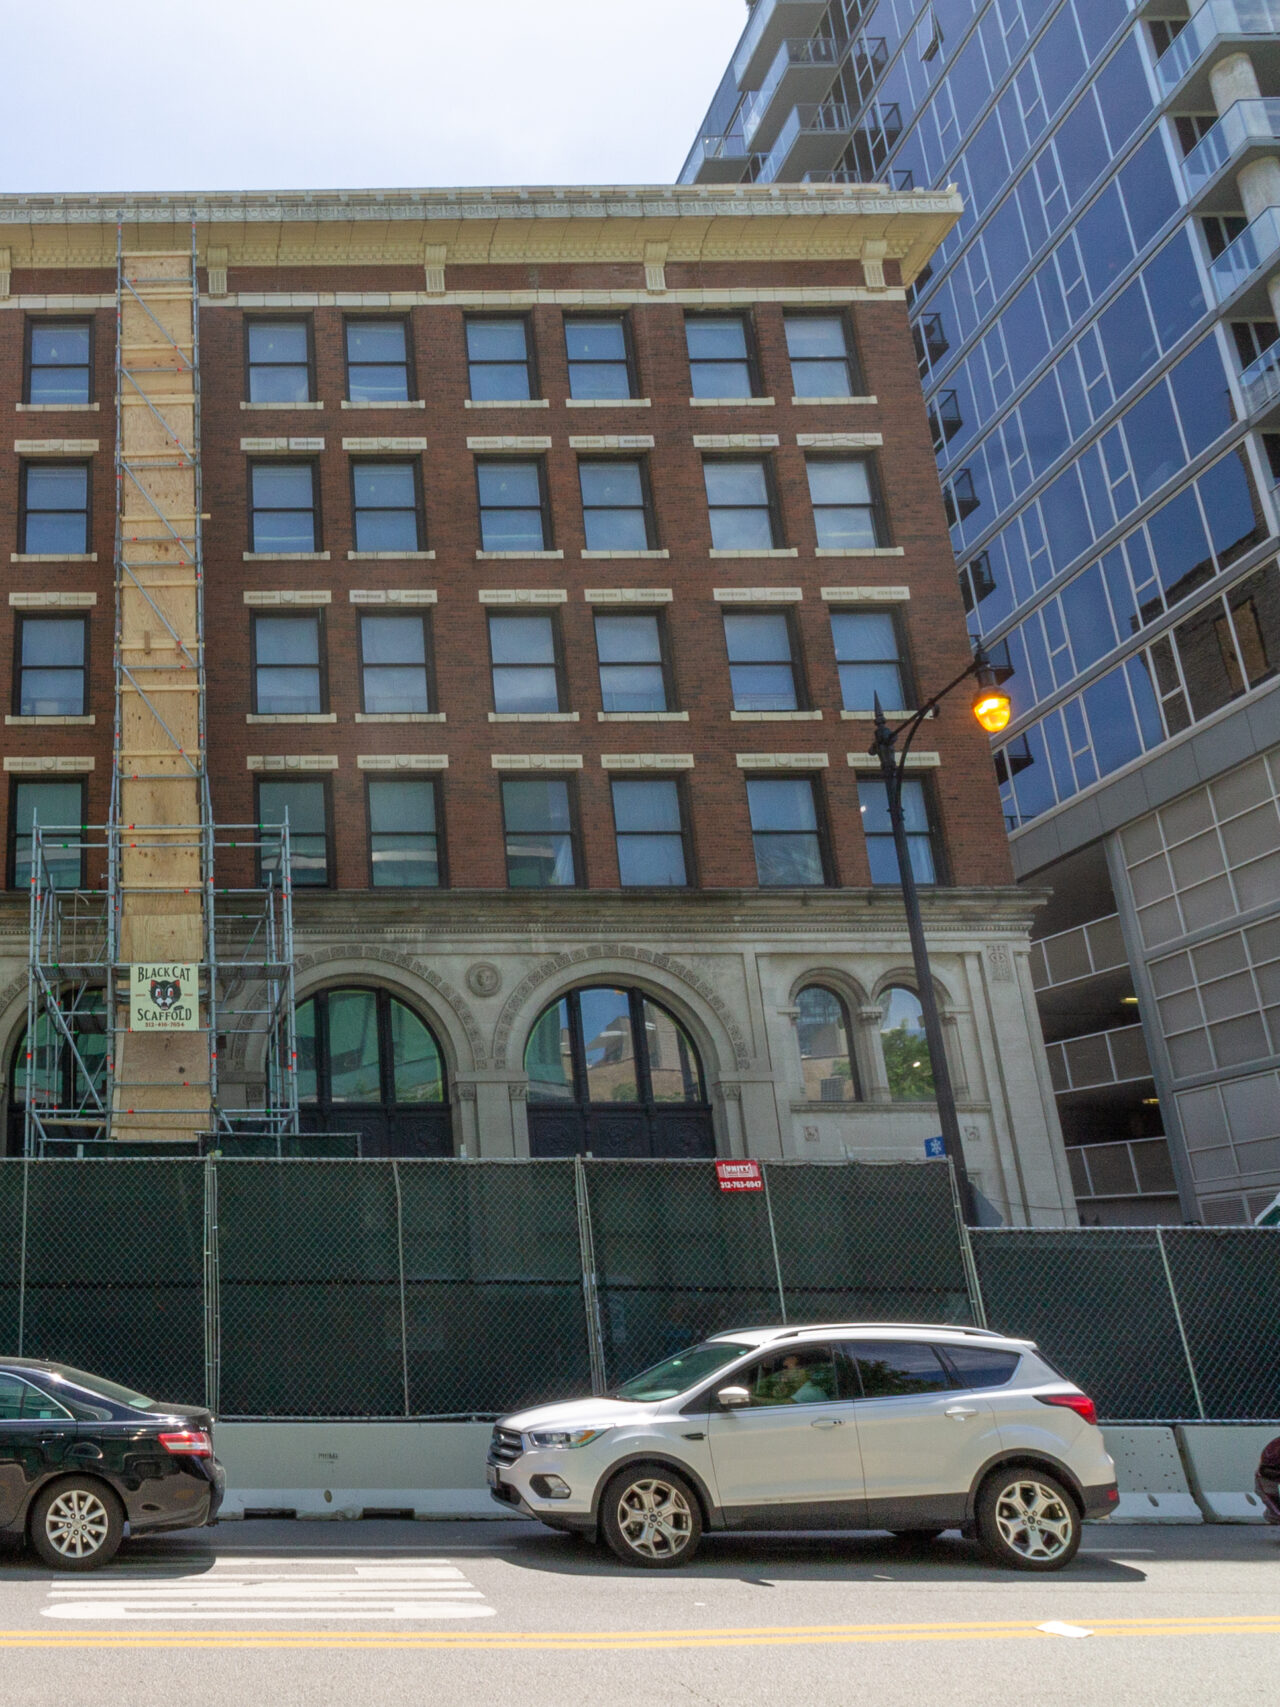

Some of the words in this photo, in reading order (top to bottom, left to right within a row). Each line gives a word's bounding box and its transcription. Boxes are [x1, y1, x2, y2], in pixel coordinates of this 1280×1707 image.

[137, 966, 171, 983] BLACK
[172, 965, 191, 982] CAT
[137, 1008, 192, 1021] SCAFFOLD
